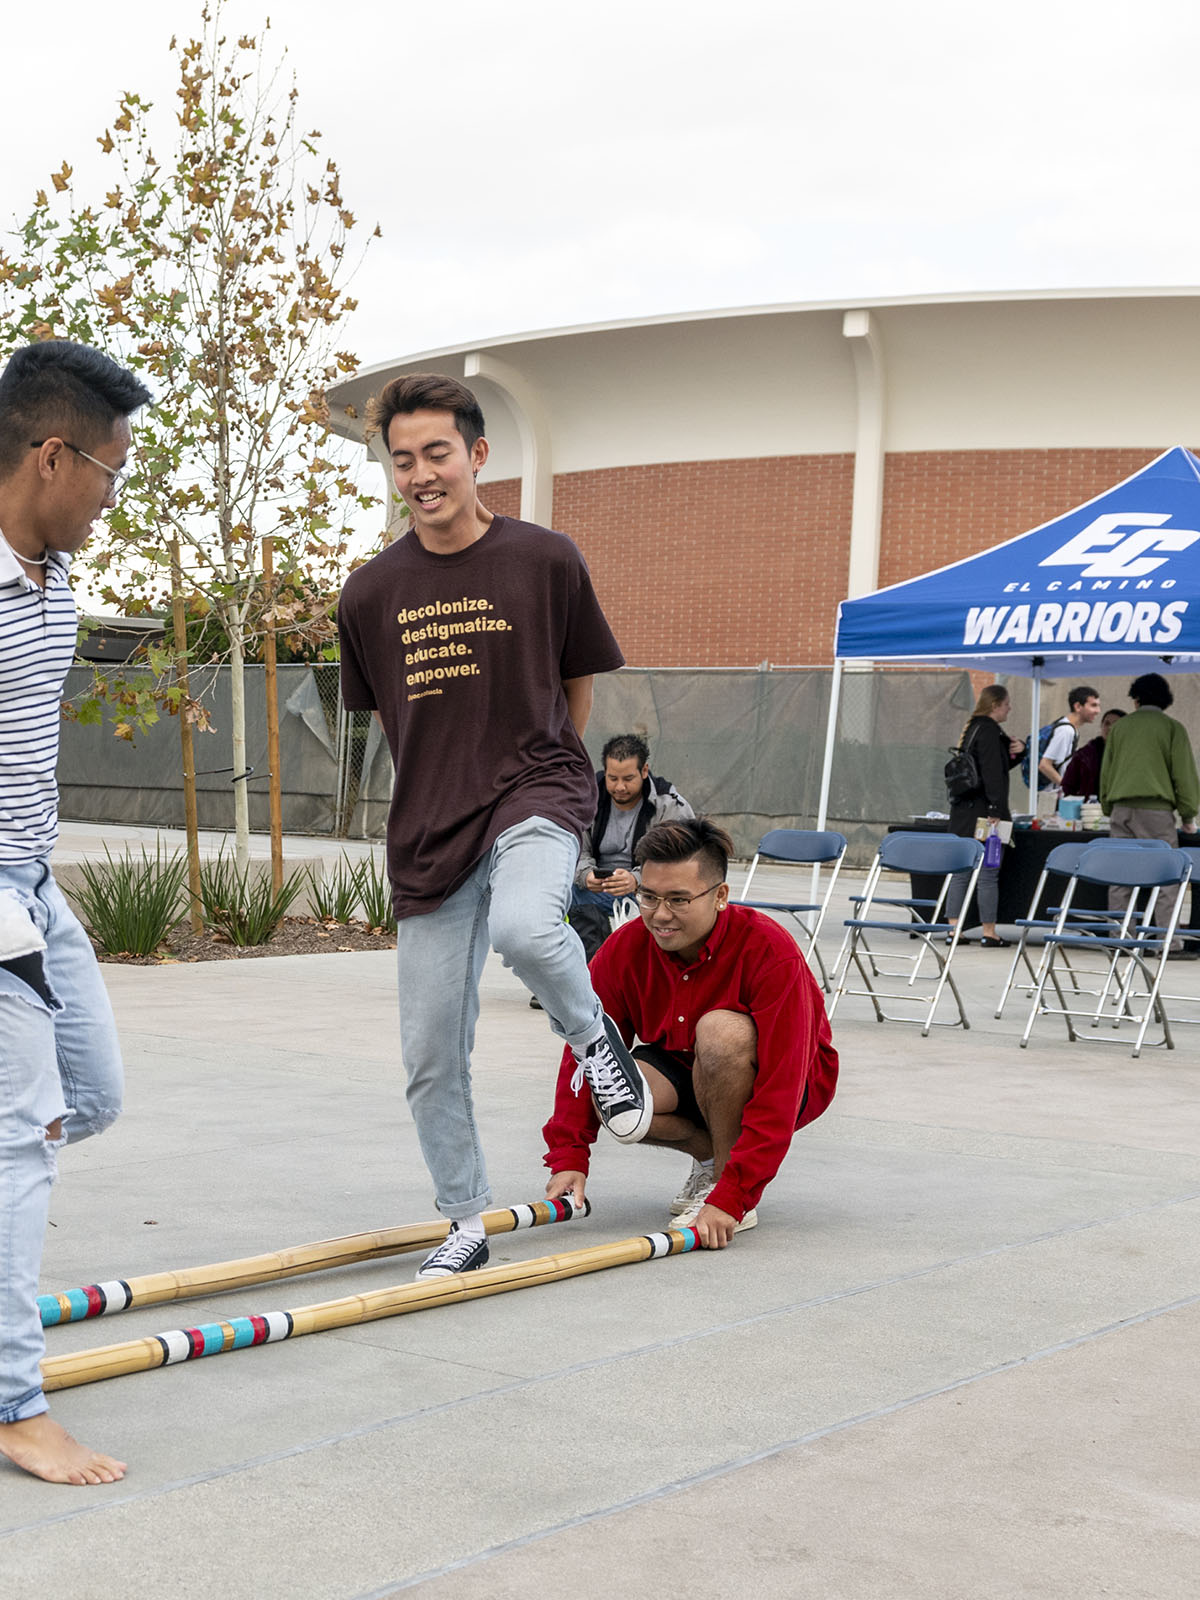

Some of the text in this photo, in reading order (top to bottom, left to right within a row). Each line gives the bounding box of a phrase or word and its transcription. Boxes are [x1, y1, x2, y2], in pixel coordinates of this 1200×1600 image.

[1003, 579, 1177, 593] EL CAMINO
[397, 597, 494, 625] decolonize.
[963, 600, 1189, 645] WARRIORS
[401, 616, 513, 645] destigmatize.
[405, 642, 473, 665] educate.
